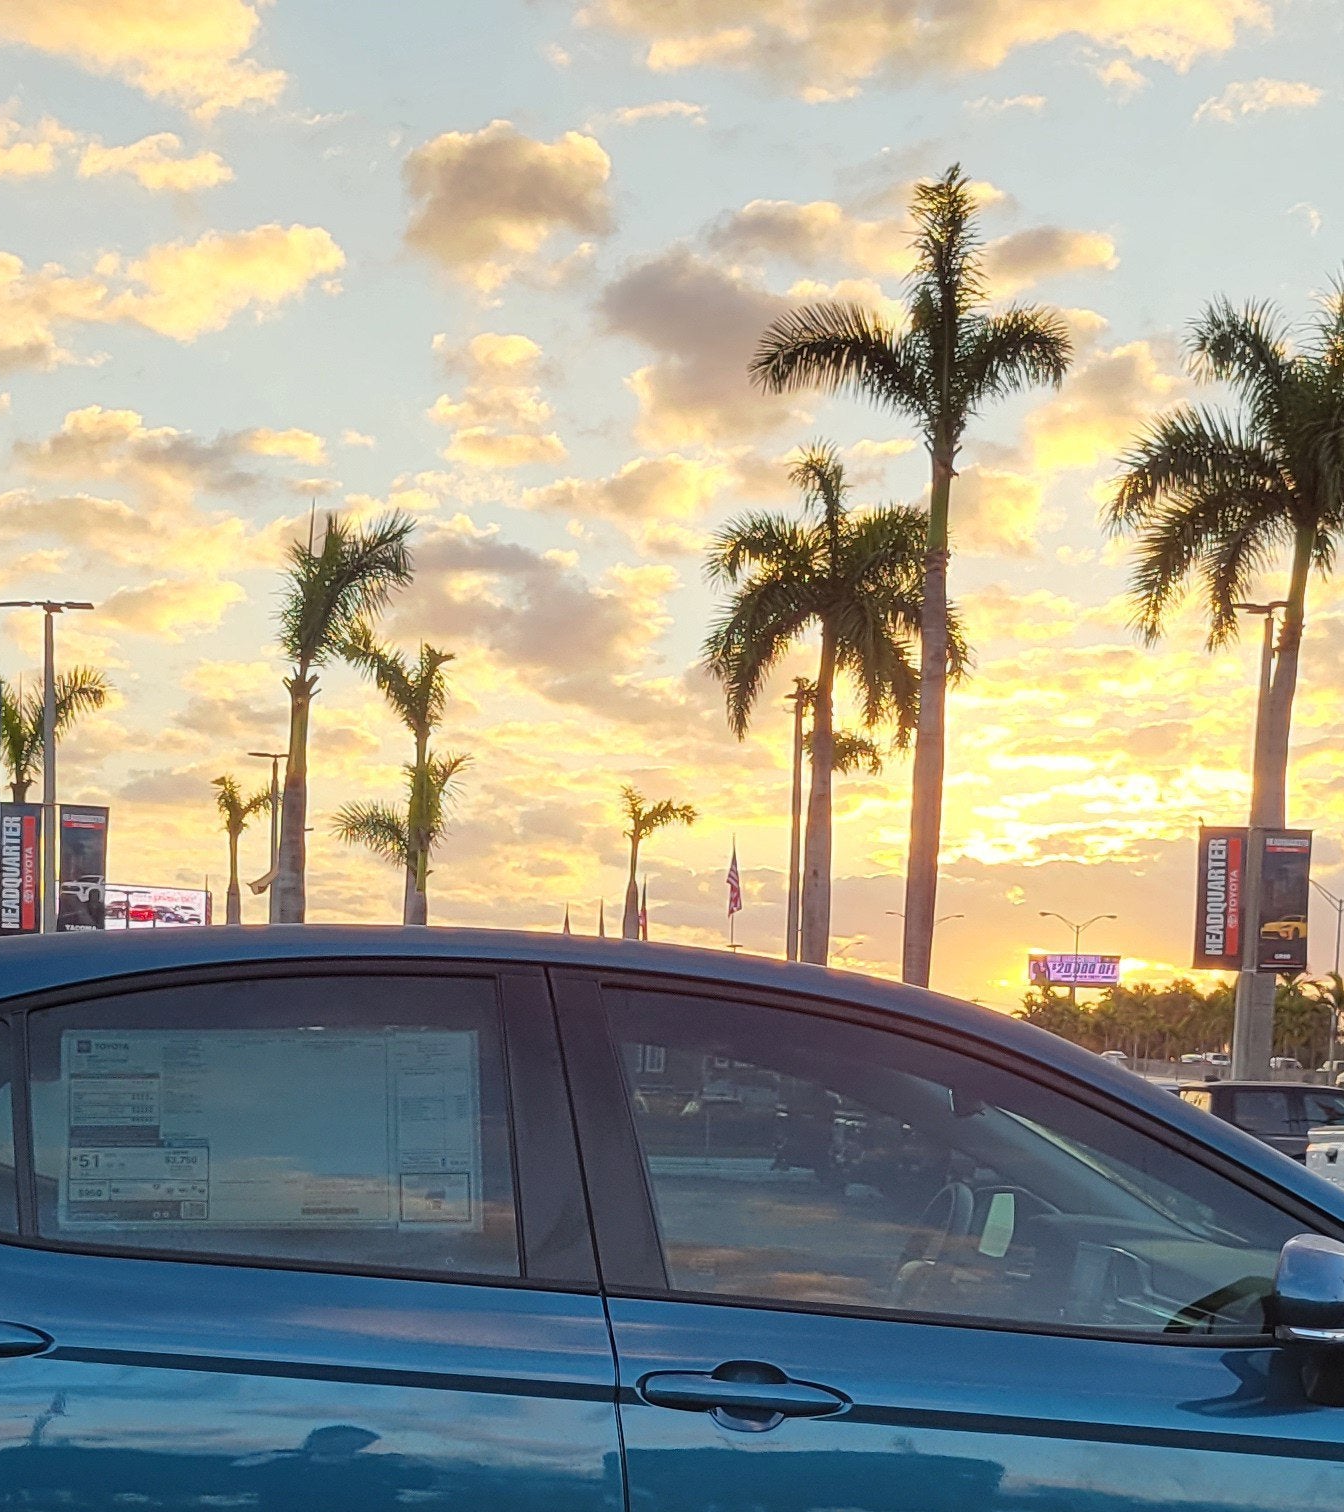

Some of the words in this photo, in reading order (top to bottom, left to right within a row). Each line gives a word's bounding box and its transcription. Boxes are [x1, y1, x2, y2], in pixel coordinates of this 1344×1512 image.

[0, 815, 23, 929] HEADQUARTER
[25, 846, 34, 888] TOYOTA
[1205, 838, 1228, 956] HEADQUARTER
[1228, 869, 1238, 914] TOYOTA
[1052, 963, 1095, 974] $20000
[94, 1043, 129, 1051] TOYOTA
[78, 1154, 101, 1169] 51
